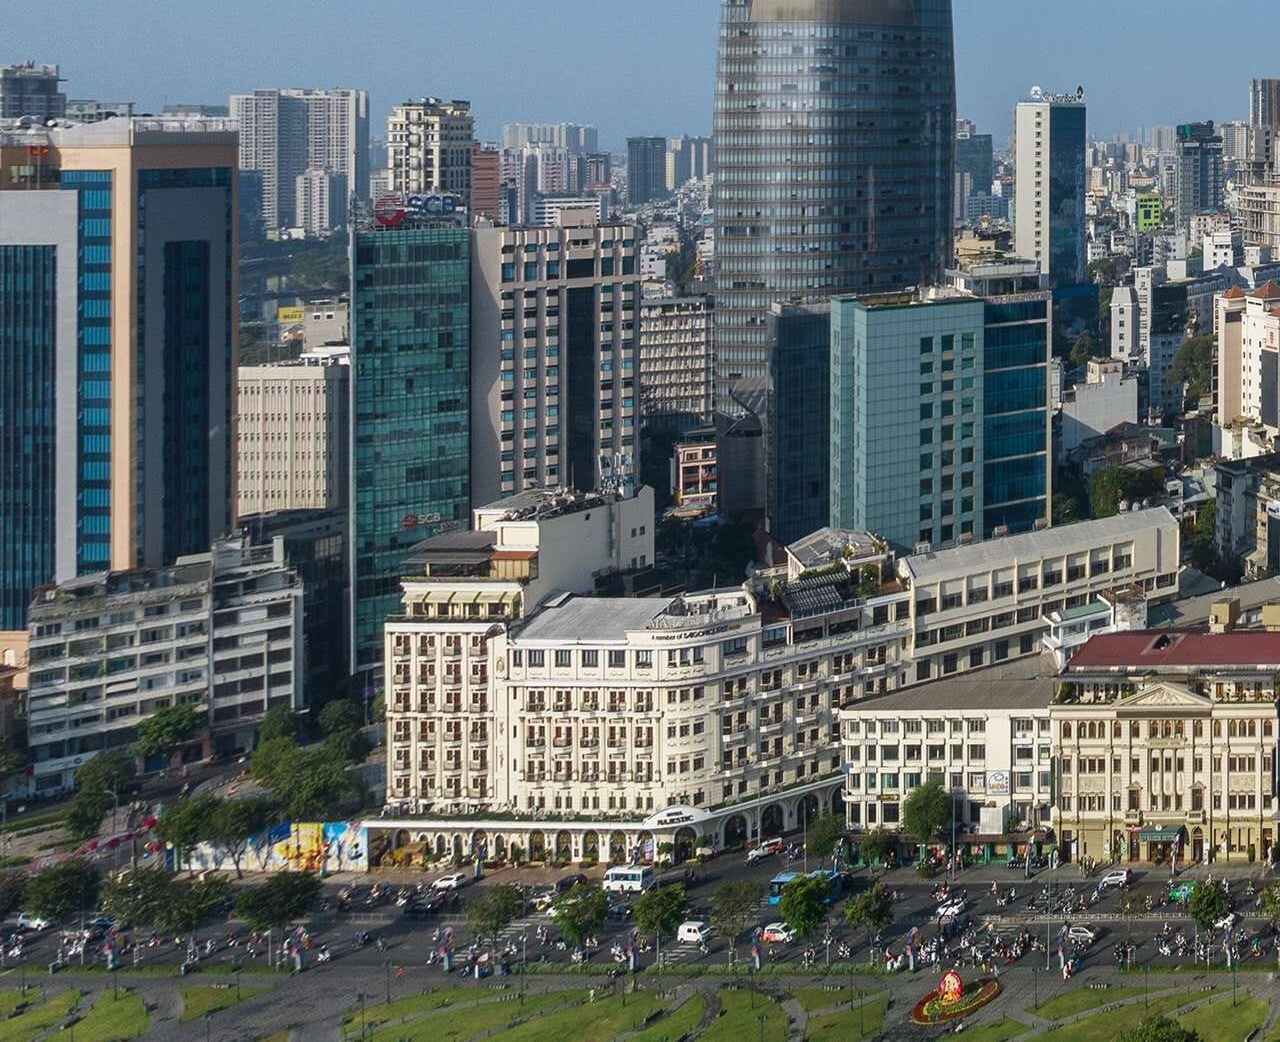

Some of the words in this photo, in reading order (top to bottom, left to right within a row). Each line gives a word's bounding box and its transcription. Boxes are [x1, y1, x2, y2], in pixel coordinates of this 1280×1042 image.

[406, 195, 456, 216] SCB
[418, 512, 441, 525] SCB
[657, 814, 695, 826] MAJESTIC
